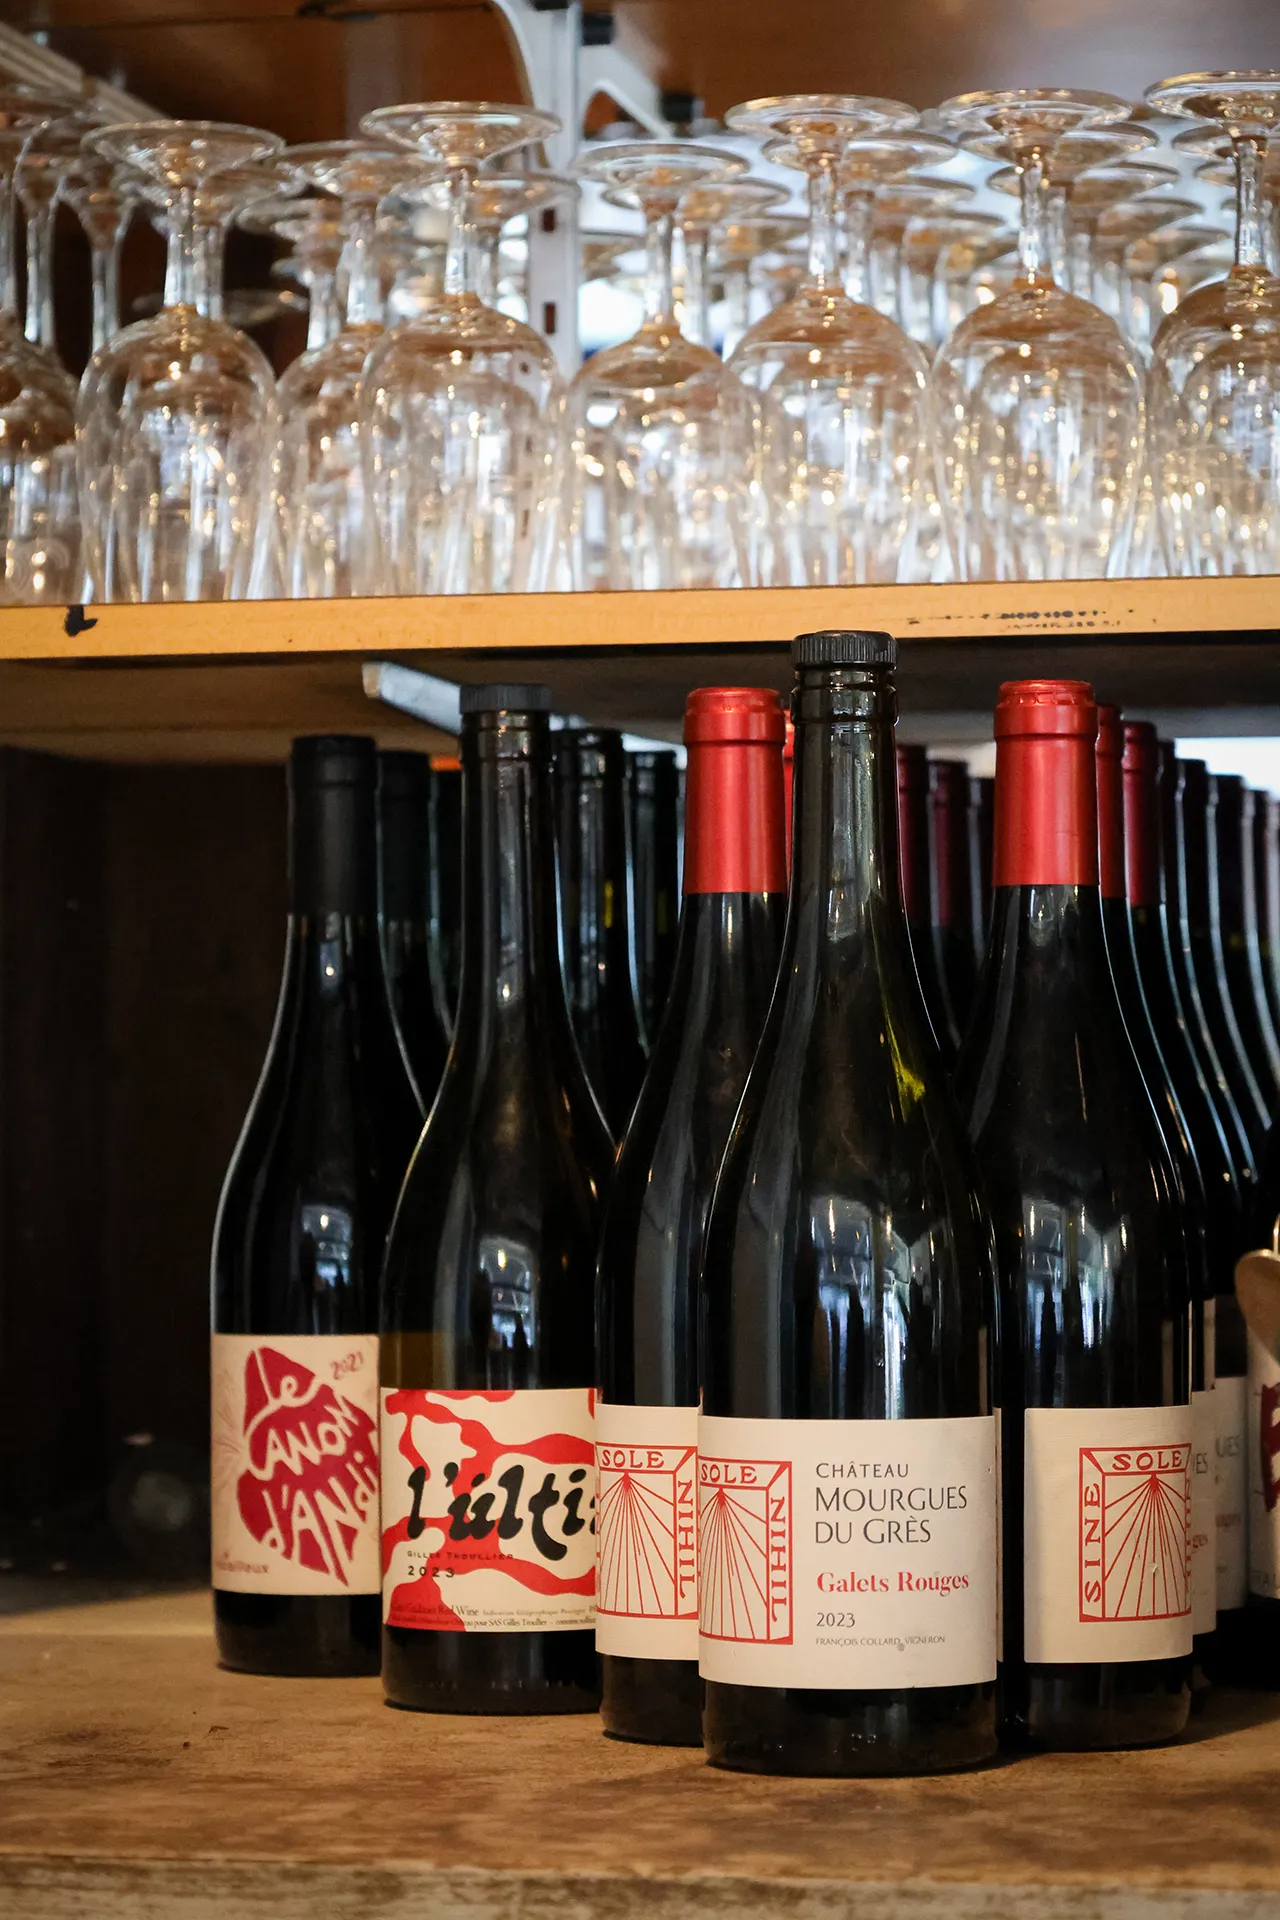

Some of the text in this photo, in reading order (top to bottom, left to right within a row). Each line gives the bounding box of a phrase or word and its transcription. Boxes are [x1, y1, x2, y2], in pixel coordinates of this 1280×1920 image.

[601, 1448, 665, 1469] SOLE
[815, 1460, 909, 1479] CHÂTEAU
[1112, 1450, 1183, 1472] SOLE
[701, 1462, 757, 1485] SOLE
[815, 1485, 968, 1512] MOURGUES
[407, 1461, 596, 1562] l'últi
[677, 1480, 694, 1600] NIHIL
[815, 1515, 931, 1544] DU GRÈS
[1083, 1482, 1102, 1604] SINE
[769, 1497, 787, 1623] NIHIL
[407, 1565, 455, 1578] 2023
[816, 1571, 969, 1597] Galets Rouges
[455, 1604, 479, 1617] Wine
[815, 1612, 856, 1628] 2023
[488, 1618, 502, 1627] SAS
[815, 1637, 859, 1648] FRANÇOIS
[904, 1634, 946, 1645] VIGNERON
